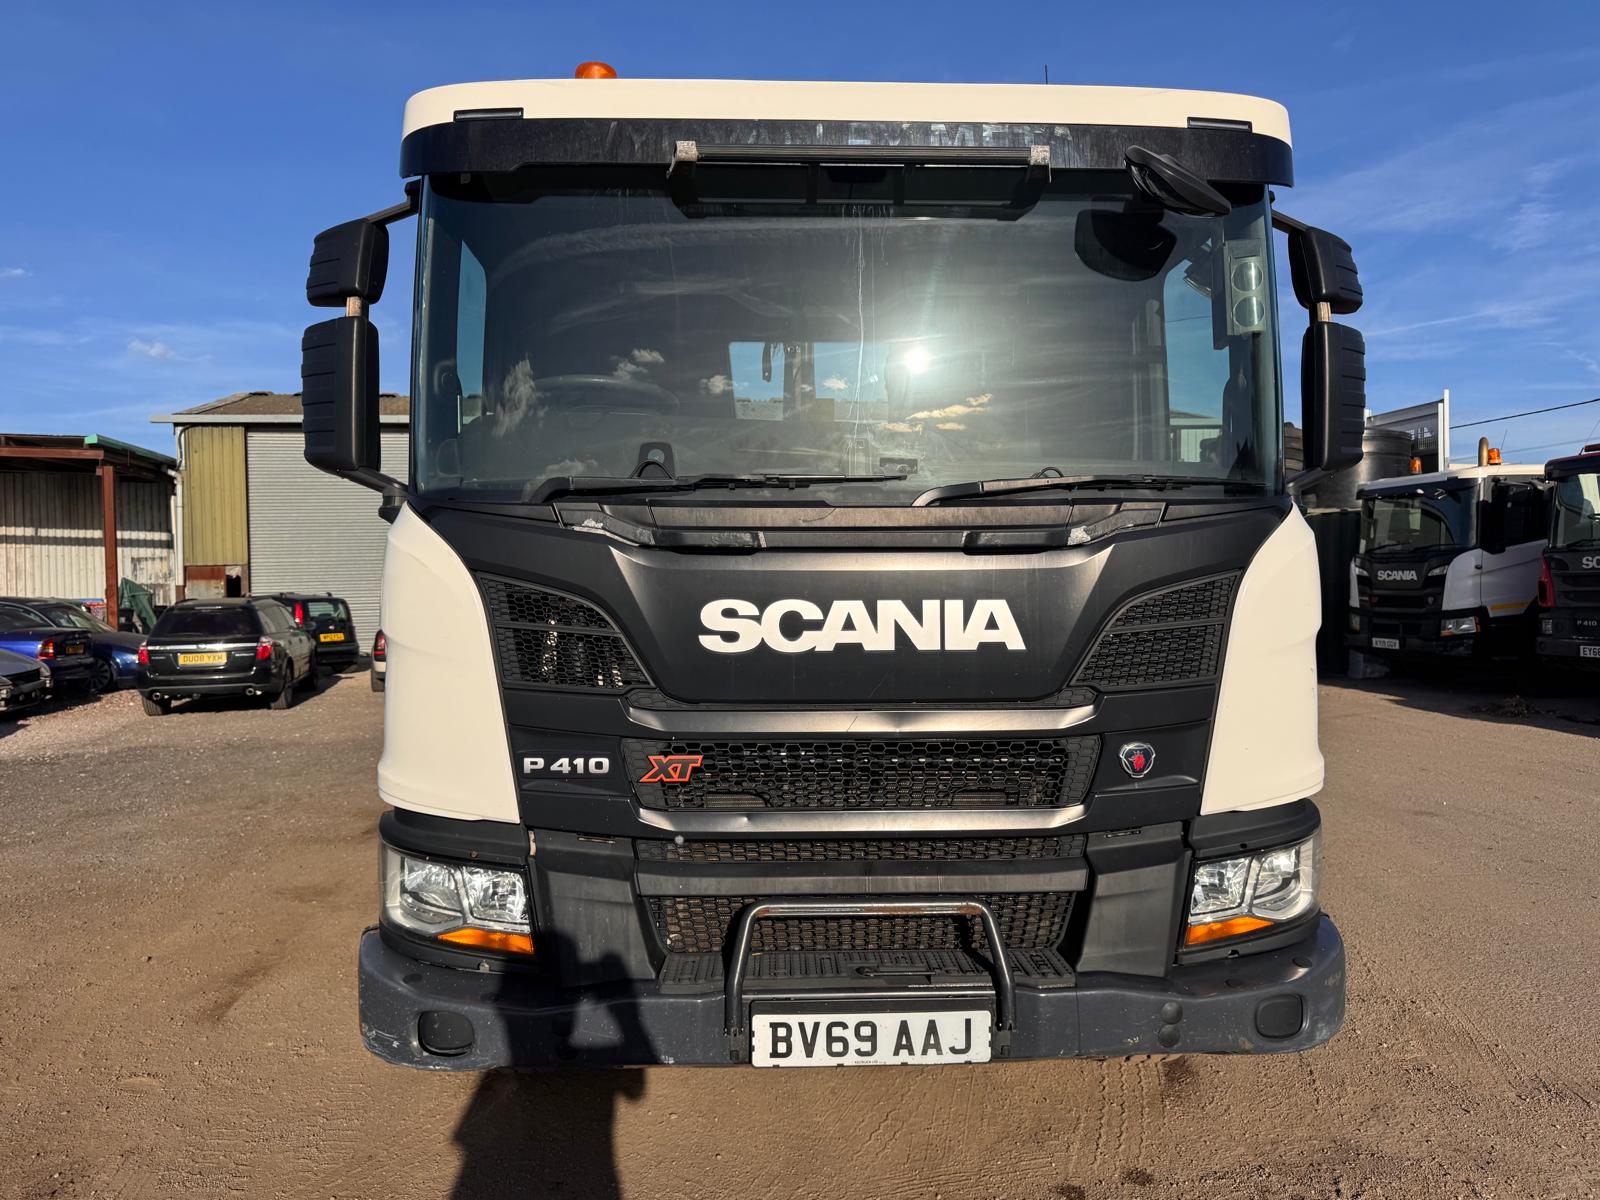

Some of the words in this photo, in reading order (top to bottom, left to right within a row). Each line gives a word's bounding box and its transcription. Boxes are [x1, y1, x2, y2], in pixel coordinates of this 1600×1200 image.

[1377, 570, 1418, 581] SCANIA
[698, 599, 1027, 653] SCANIA
[523, 757, 545, 774] P
[550, 757, 610, 774] 410
[639, 755, 703, 782] XT
[769, 1020, 878, 1058] BV69
[893, 1018, 972, 1056] AAJ
